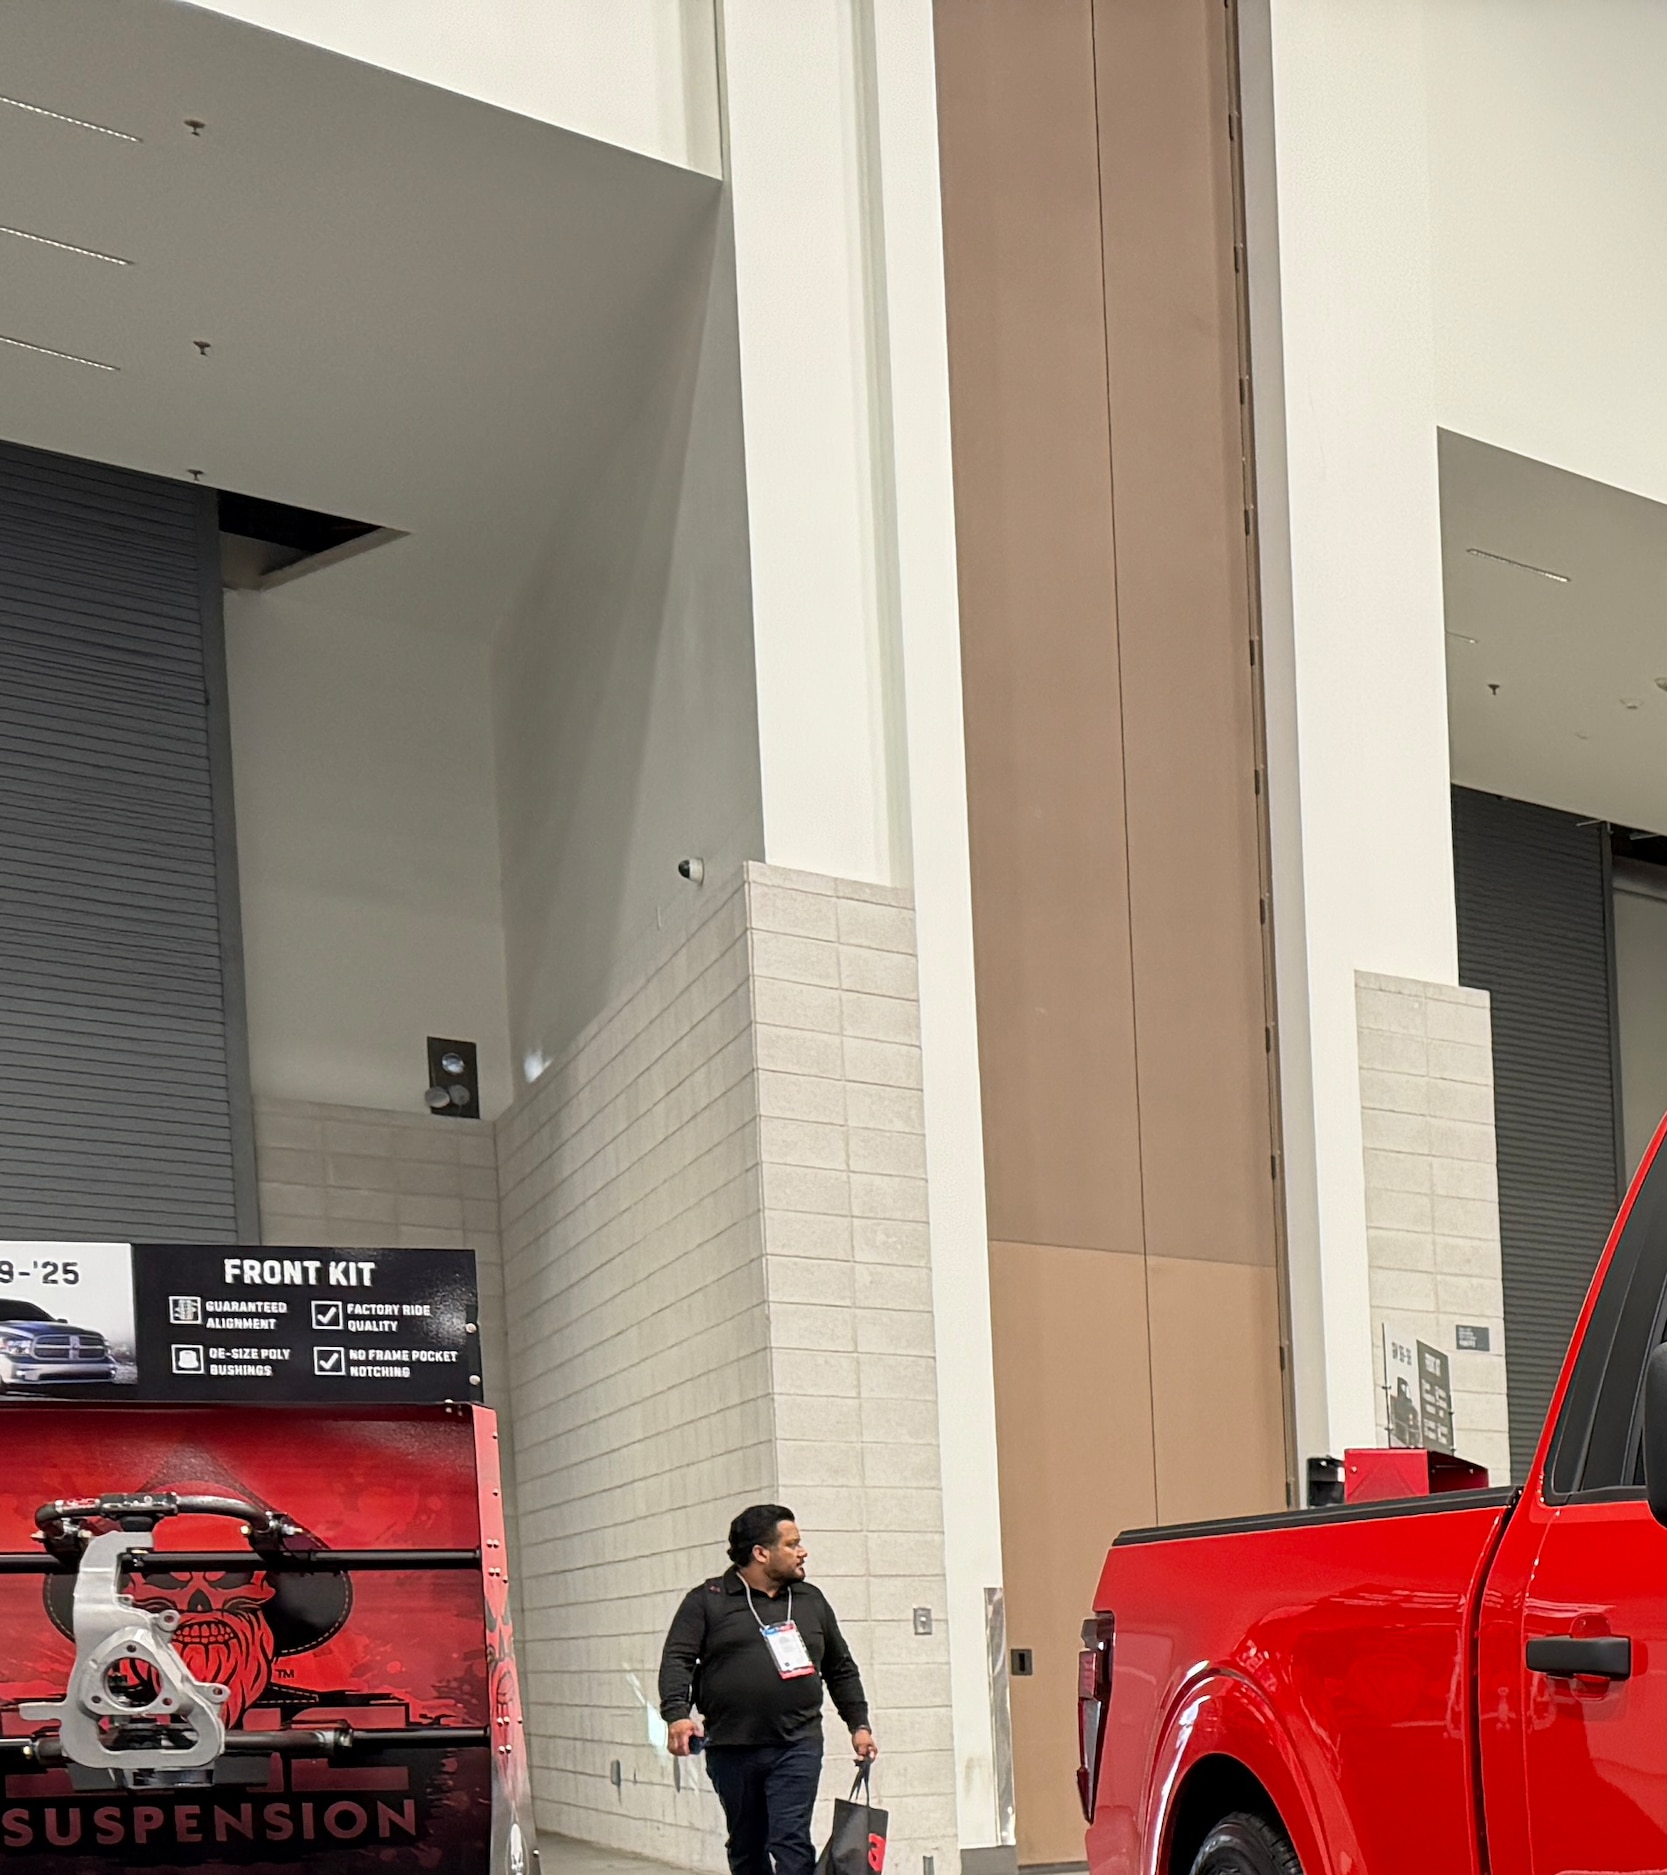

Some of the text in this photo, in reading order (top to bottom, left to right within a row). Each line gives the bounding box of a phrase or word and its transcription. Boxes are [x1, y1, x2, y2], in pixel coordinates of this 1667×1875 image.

[224, 1258, 376, 1287] FRONT KIT
[206, 1301, 287, 1313] GUARANTEED
[347, 1304, 431, 1316] FACTORY RIDE
[206, 1318, 277, 1330] ALIGNMENT
[348, 1320, 398, 1332] QUALITY
[209, 1348, 290, 1360] OE-SIZE POLY
[350, 1350, 458, 1363] NO FRAME POCKET
[210, 1365, 272, 1377] BUSHINGS
[350, 1366, 410, 1378] NOTCHING
[275, 1669, 294, 1679] TM
[1, 1799, 417, 1847] SUSPENSION
